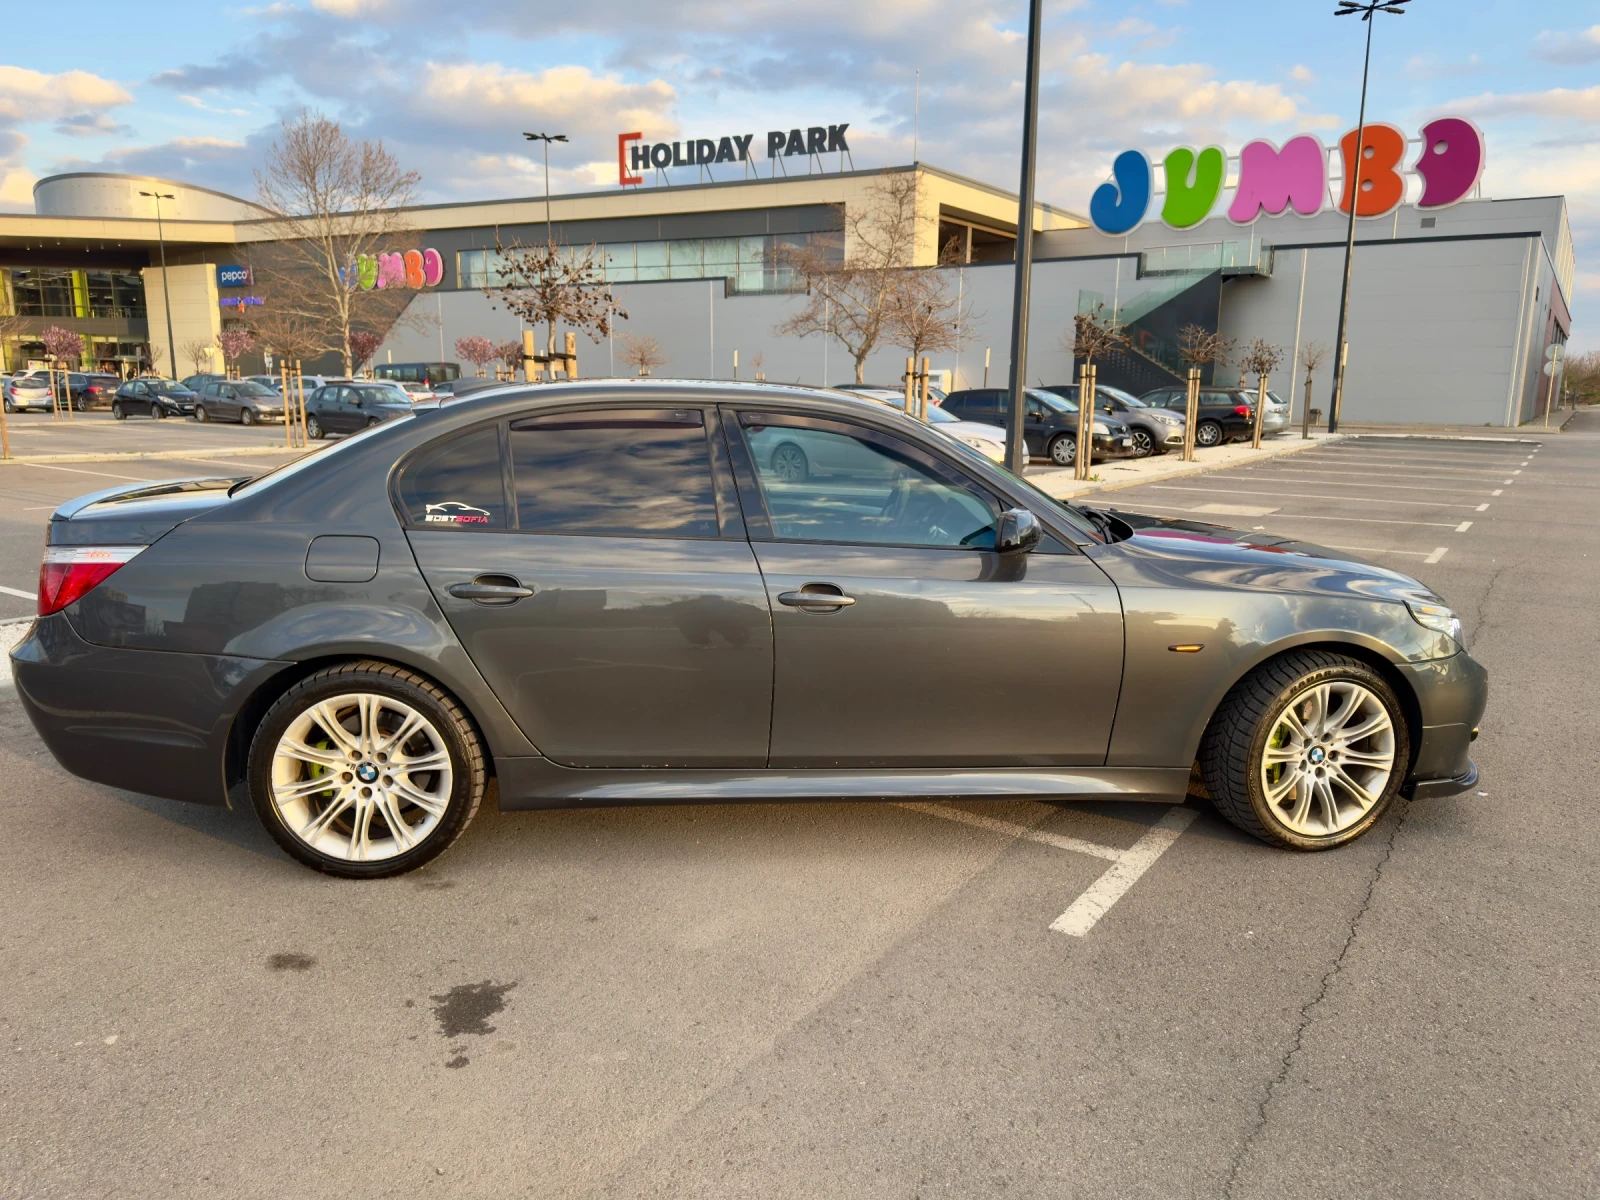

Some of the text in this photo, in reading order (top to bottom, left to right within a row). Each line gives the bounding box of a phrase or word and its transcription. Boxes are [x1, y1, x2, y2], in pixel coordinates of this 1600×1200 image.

[631, 123, 850, 171] HOLIDAY PARK
[1090, 116, 1486, 236] JUMBO
[221, 271, 248, 282] pepco
